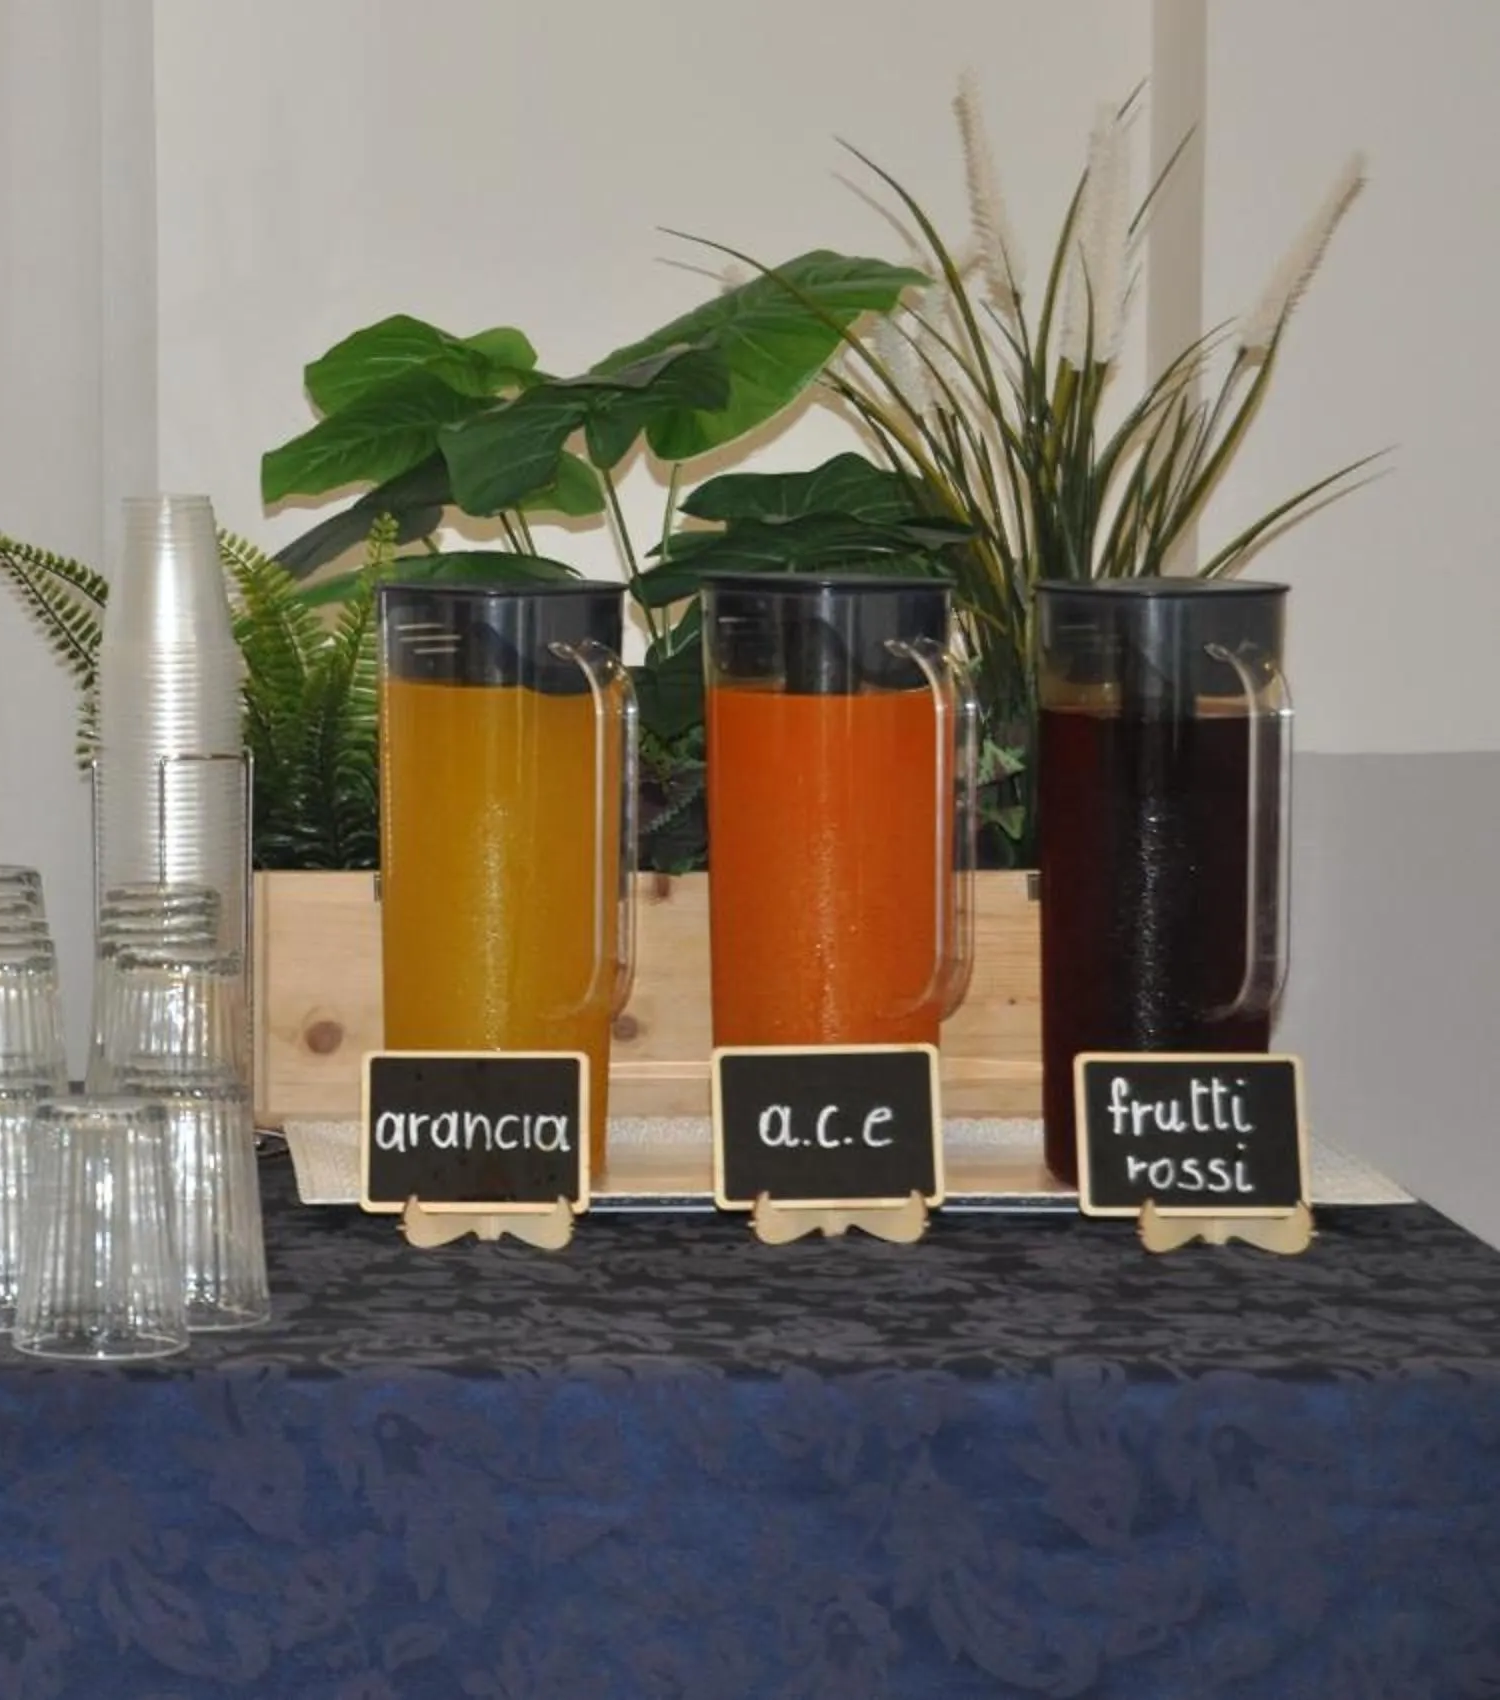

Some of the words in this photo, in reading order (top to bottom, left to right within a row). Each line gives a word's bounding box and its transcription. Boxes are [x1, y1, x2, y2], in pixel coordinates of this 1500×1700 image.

[757, 1103, 895, 1149] a.c.e
[1106, 1076, 1257, 1137] frutti
[374, 1110, 572, 1153] arancia
[1125, 1141, 1257, 1193] rossi
